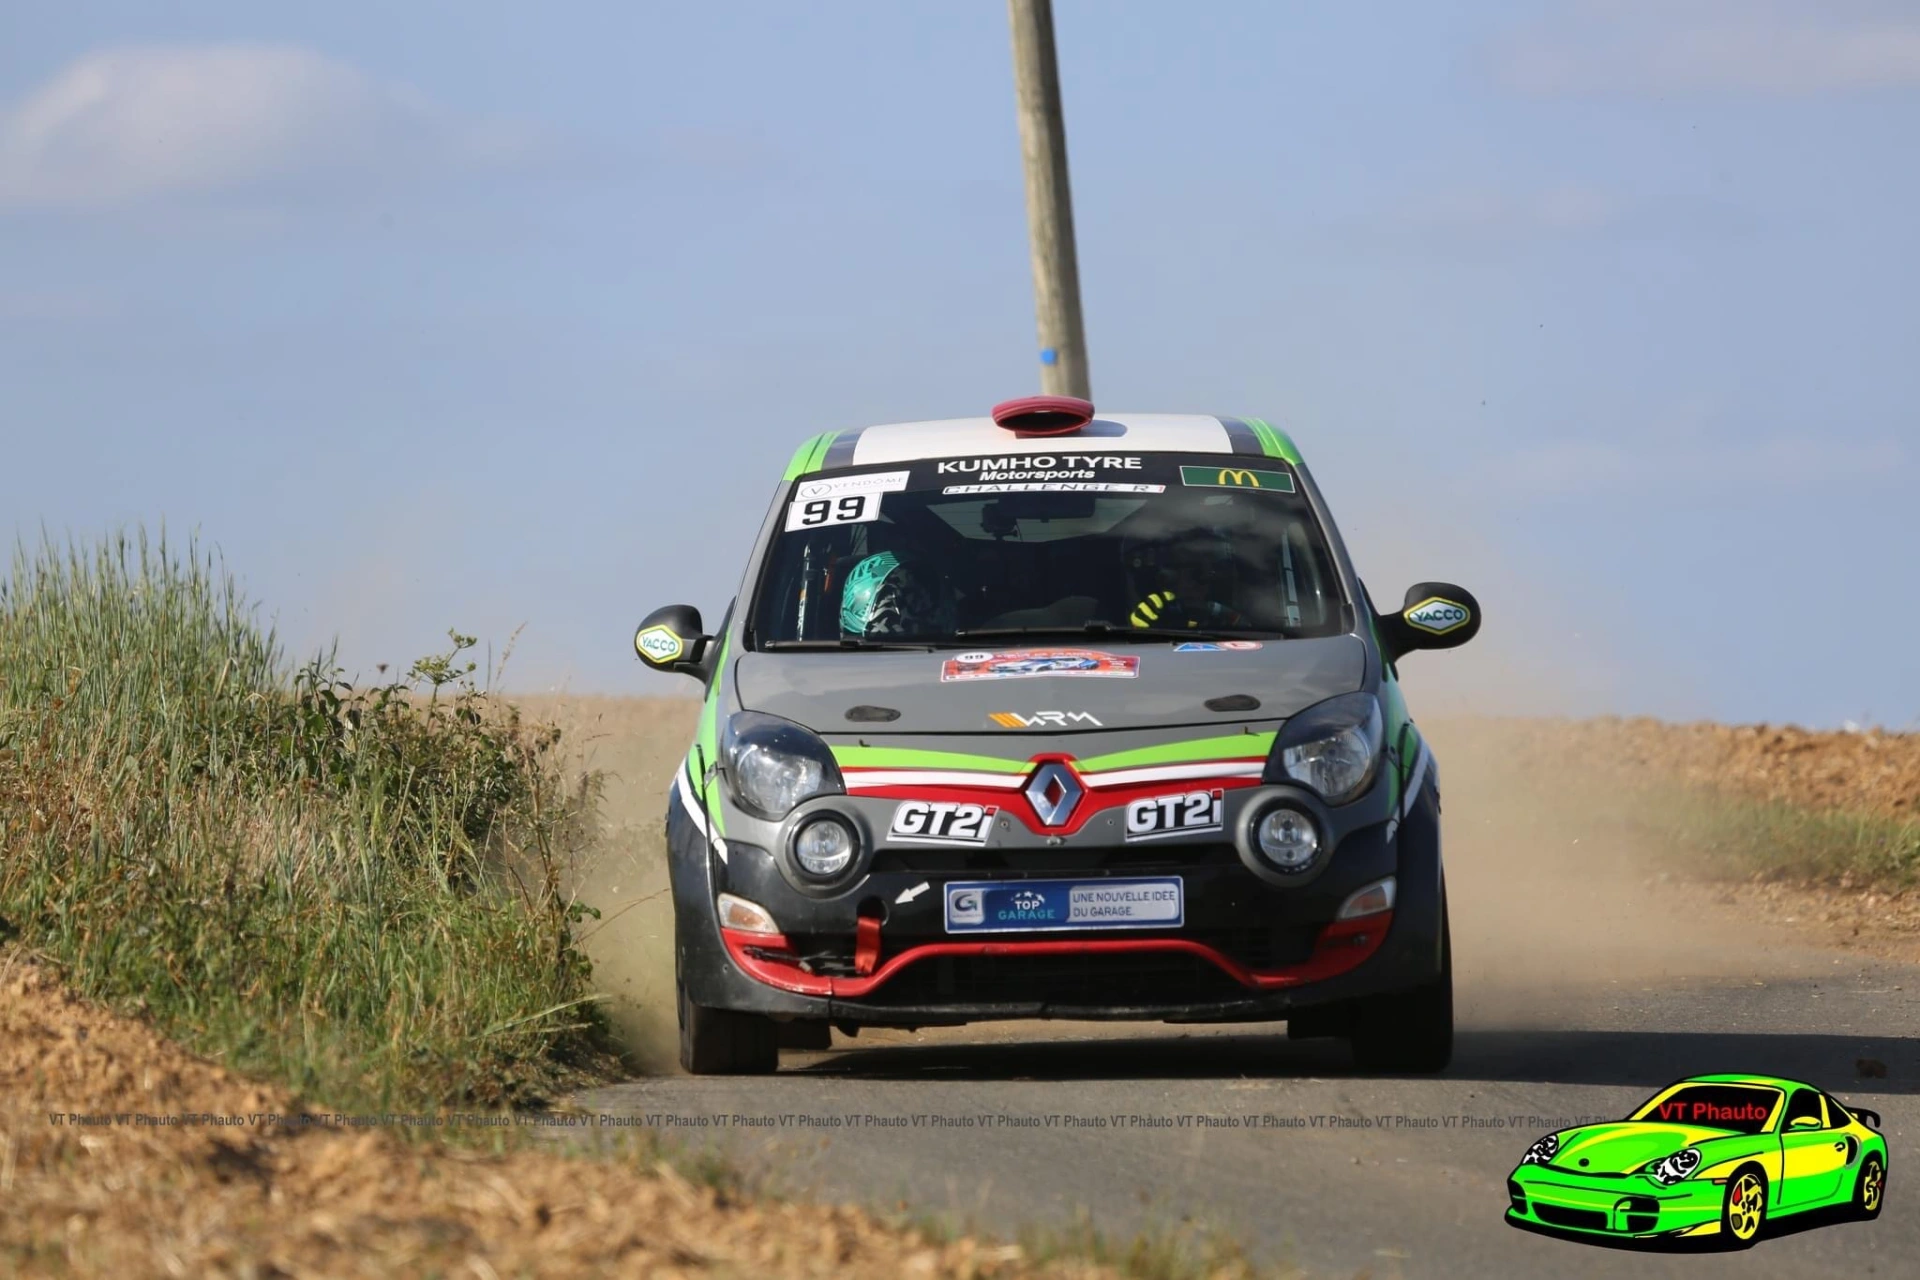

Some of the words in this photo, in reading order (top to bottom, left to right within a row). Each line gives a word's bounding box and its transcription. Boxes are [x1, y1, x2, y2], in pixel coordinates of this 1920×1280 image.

[937, 456, 1056, 474] KUMHO
[1062, 456, 1143, 470] TYRE
[979, 469, 1095, 481] Motorsports
[944, 484, 1115, 494] CHALLENGE
[802, 496, 866, 525] 99
[1415, 608, 1463, 622] YACCO
[642, 636, 676, 653] YACCO
[1126, 790, 1223, 833] GT2i
[893, 801, 996, 839] GT2i
[1073, 893, 1095, 903] UNE
[1096, 891, 1151, 902] NOUVELLE
[1014, 900, 1041, 910] TOP
[998, 909, 1057, 920] GARAGE
[1073, 907, 1088, 917] DU
